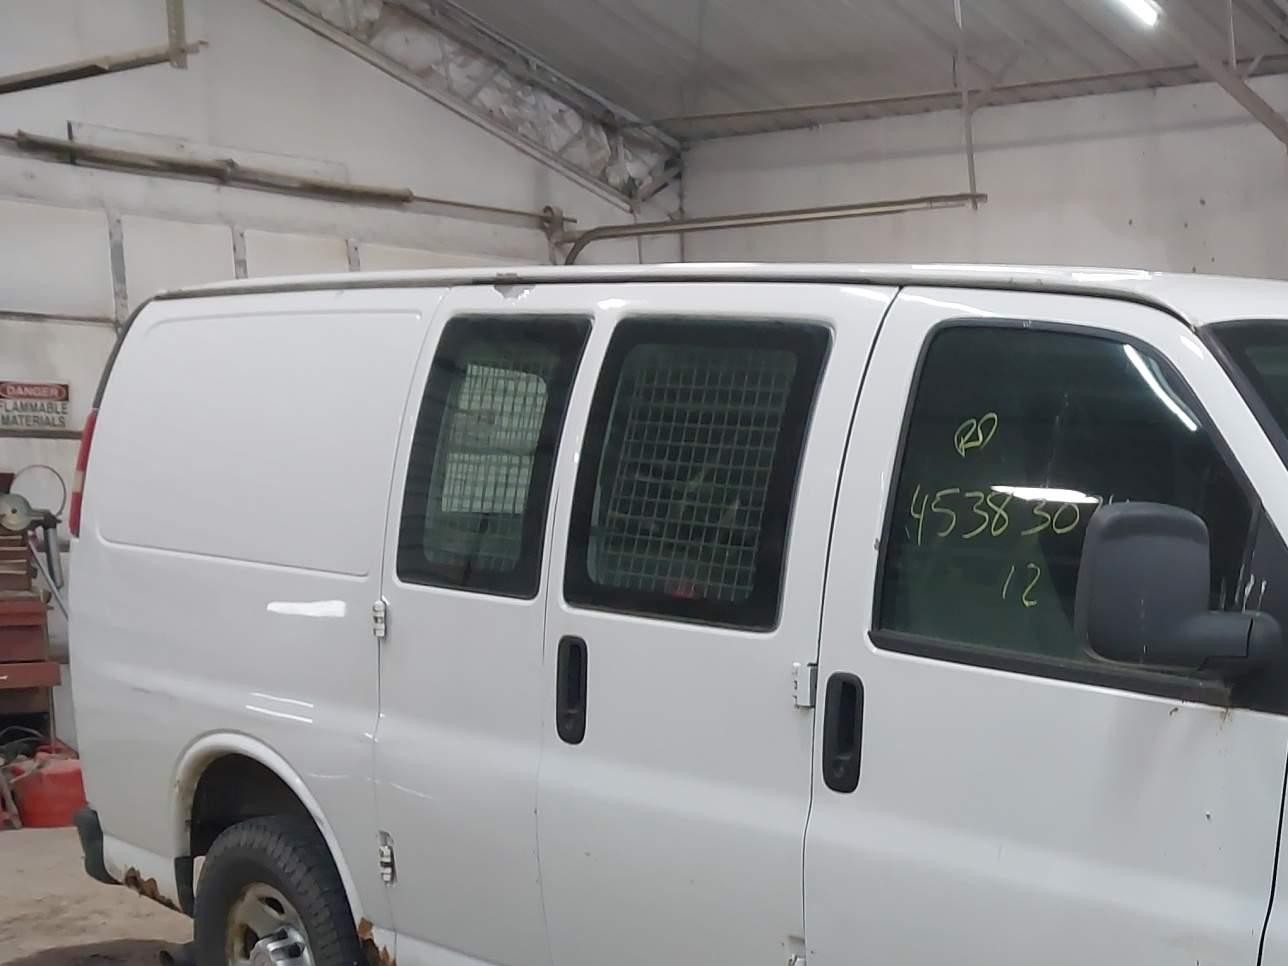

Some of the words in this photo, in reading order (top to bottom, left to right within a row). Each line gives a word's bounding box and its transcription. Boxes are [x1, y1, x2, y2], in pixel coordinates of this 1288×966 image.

[6, 385, 60, 397] DANGER
[1, 414, 66, 428] MATERIALS
[910, 484, 1114, 547] 453830
